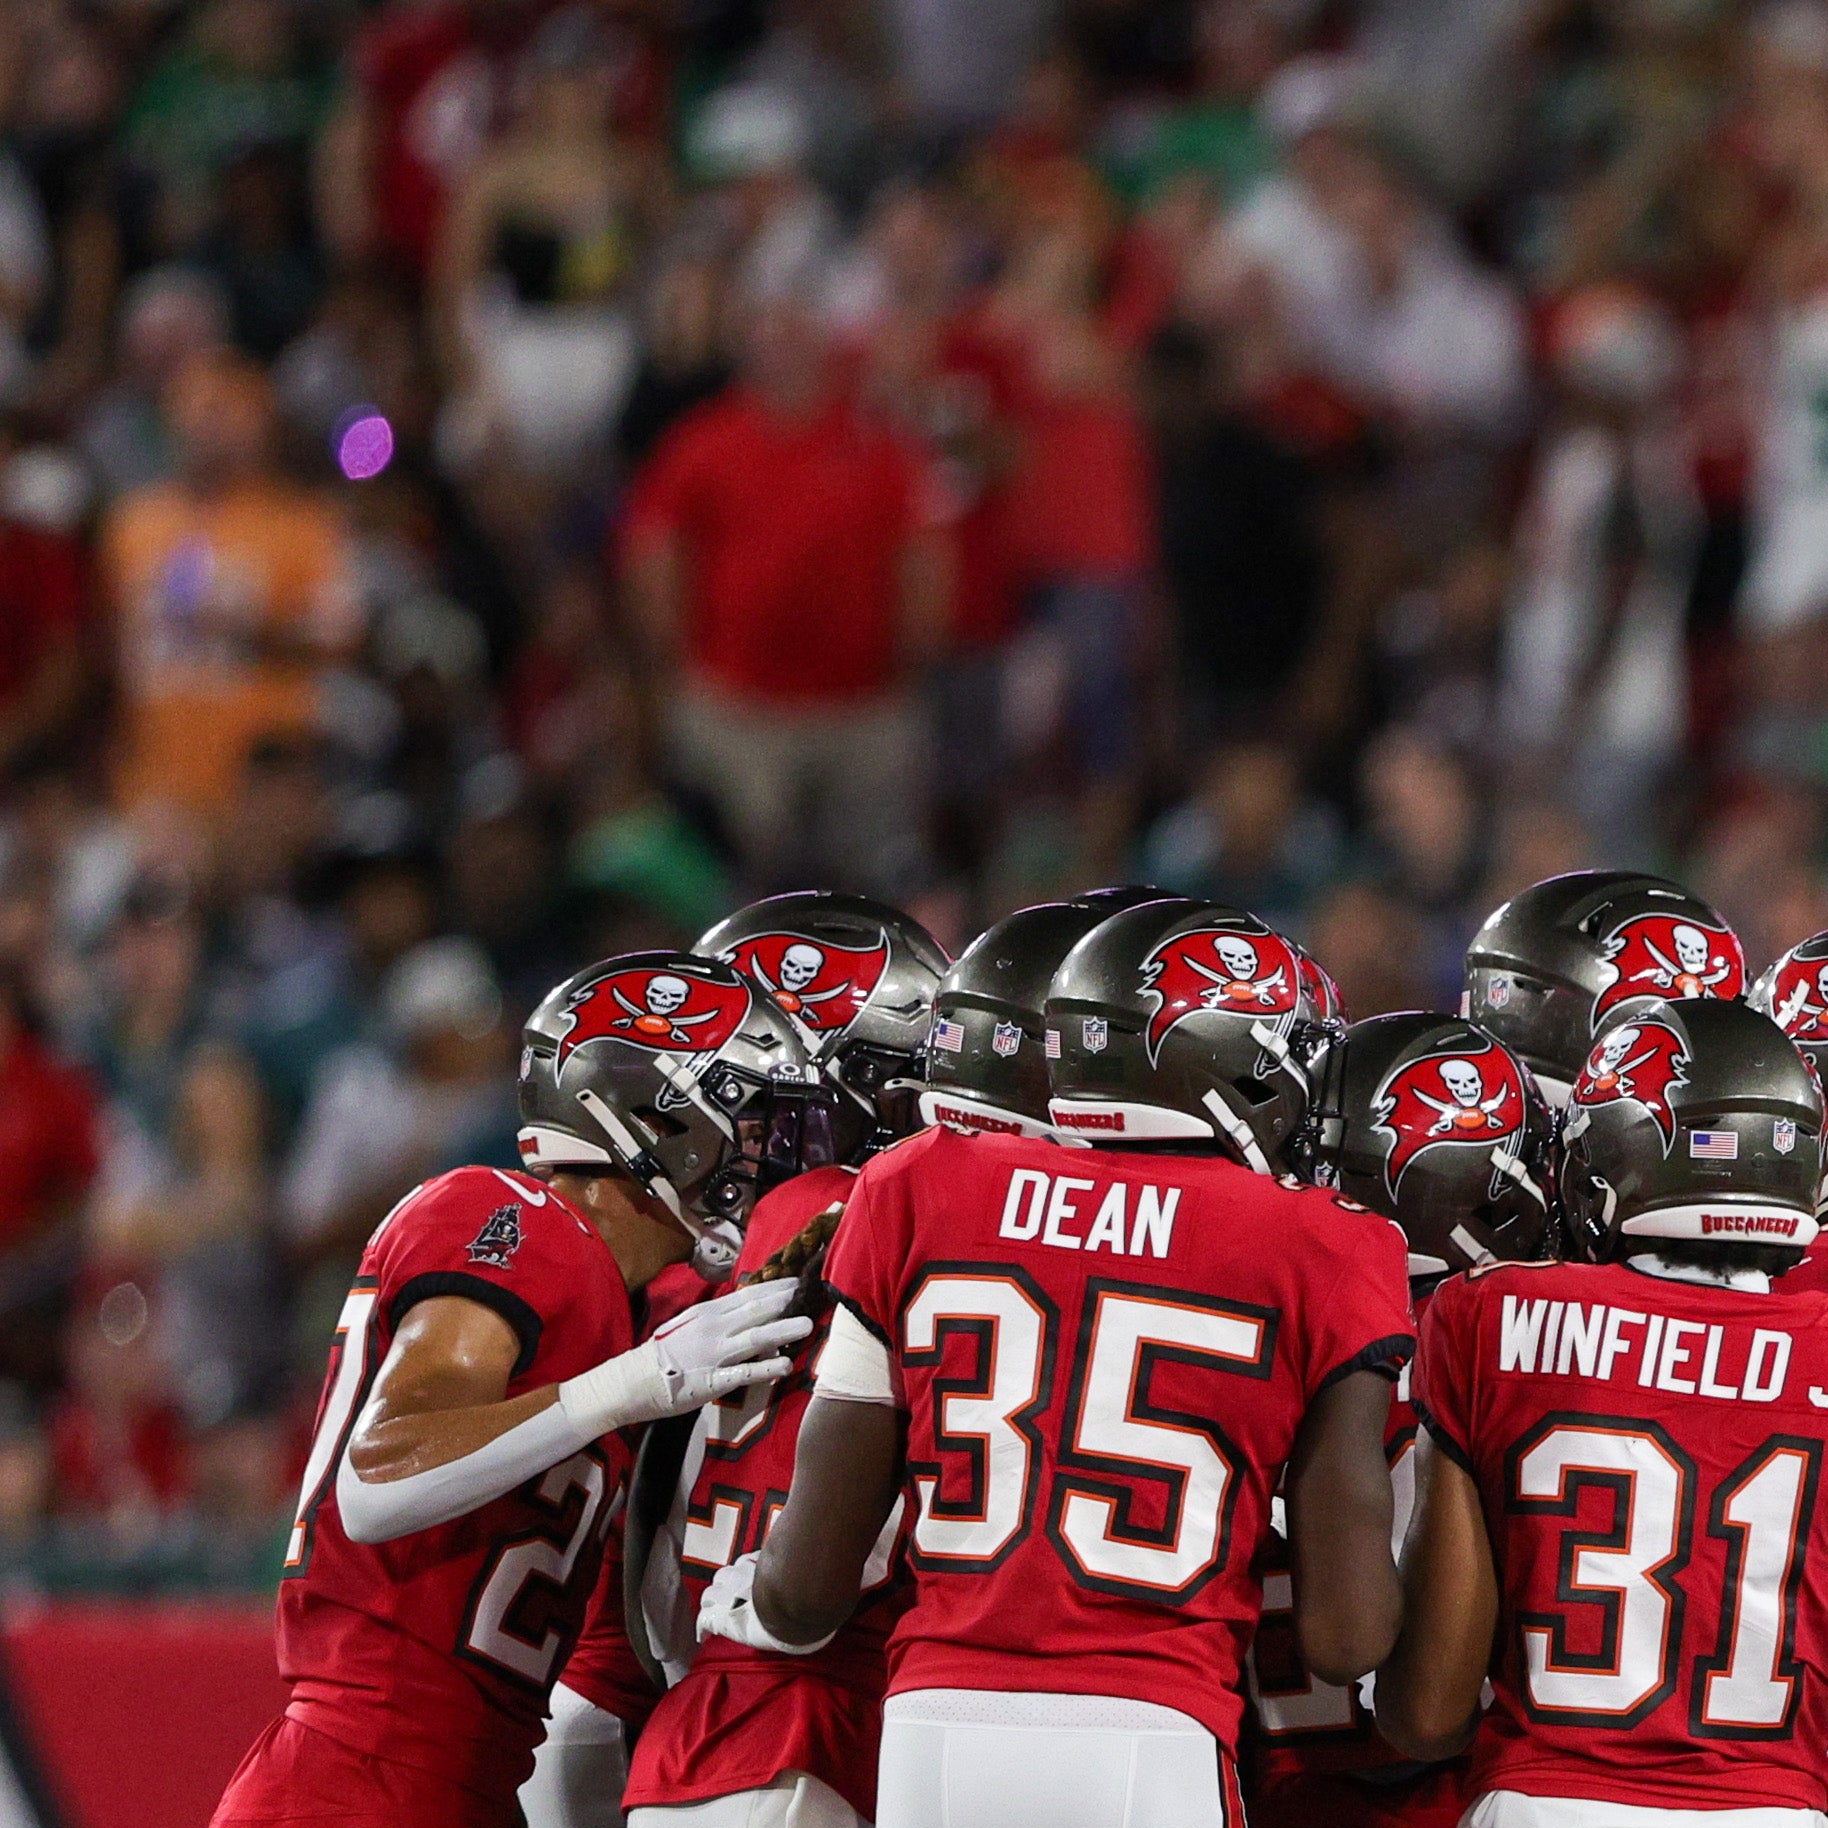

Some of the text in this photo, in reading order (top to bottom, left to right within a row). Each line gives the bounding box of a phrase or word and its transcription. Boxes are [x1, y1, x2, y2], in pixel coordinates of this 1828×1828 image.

[996, 1037, 1015, 1051] NFL
[1086, 1033, 1105, 1046] NFL
[1776, 1134, 1793, 1148] NFL
[999, 1168, 1182, 1259] DEAN
[1700, 1214, 1800, 1238] BUCCANEERS
[1499, 1294, 1792, 1403] WINFIELD
[901, 1261, 1281, 1605] 35
[1503, 1411, 1823, 1738] 31
